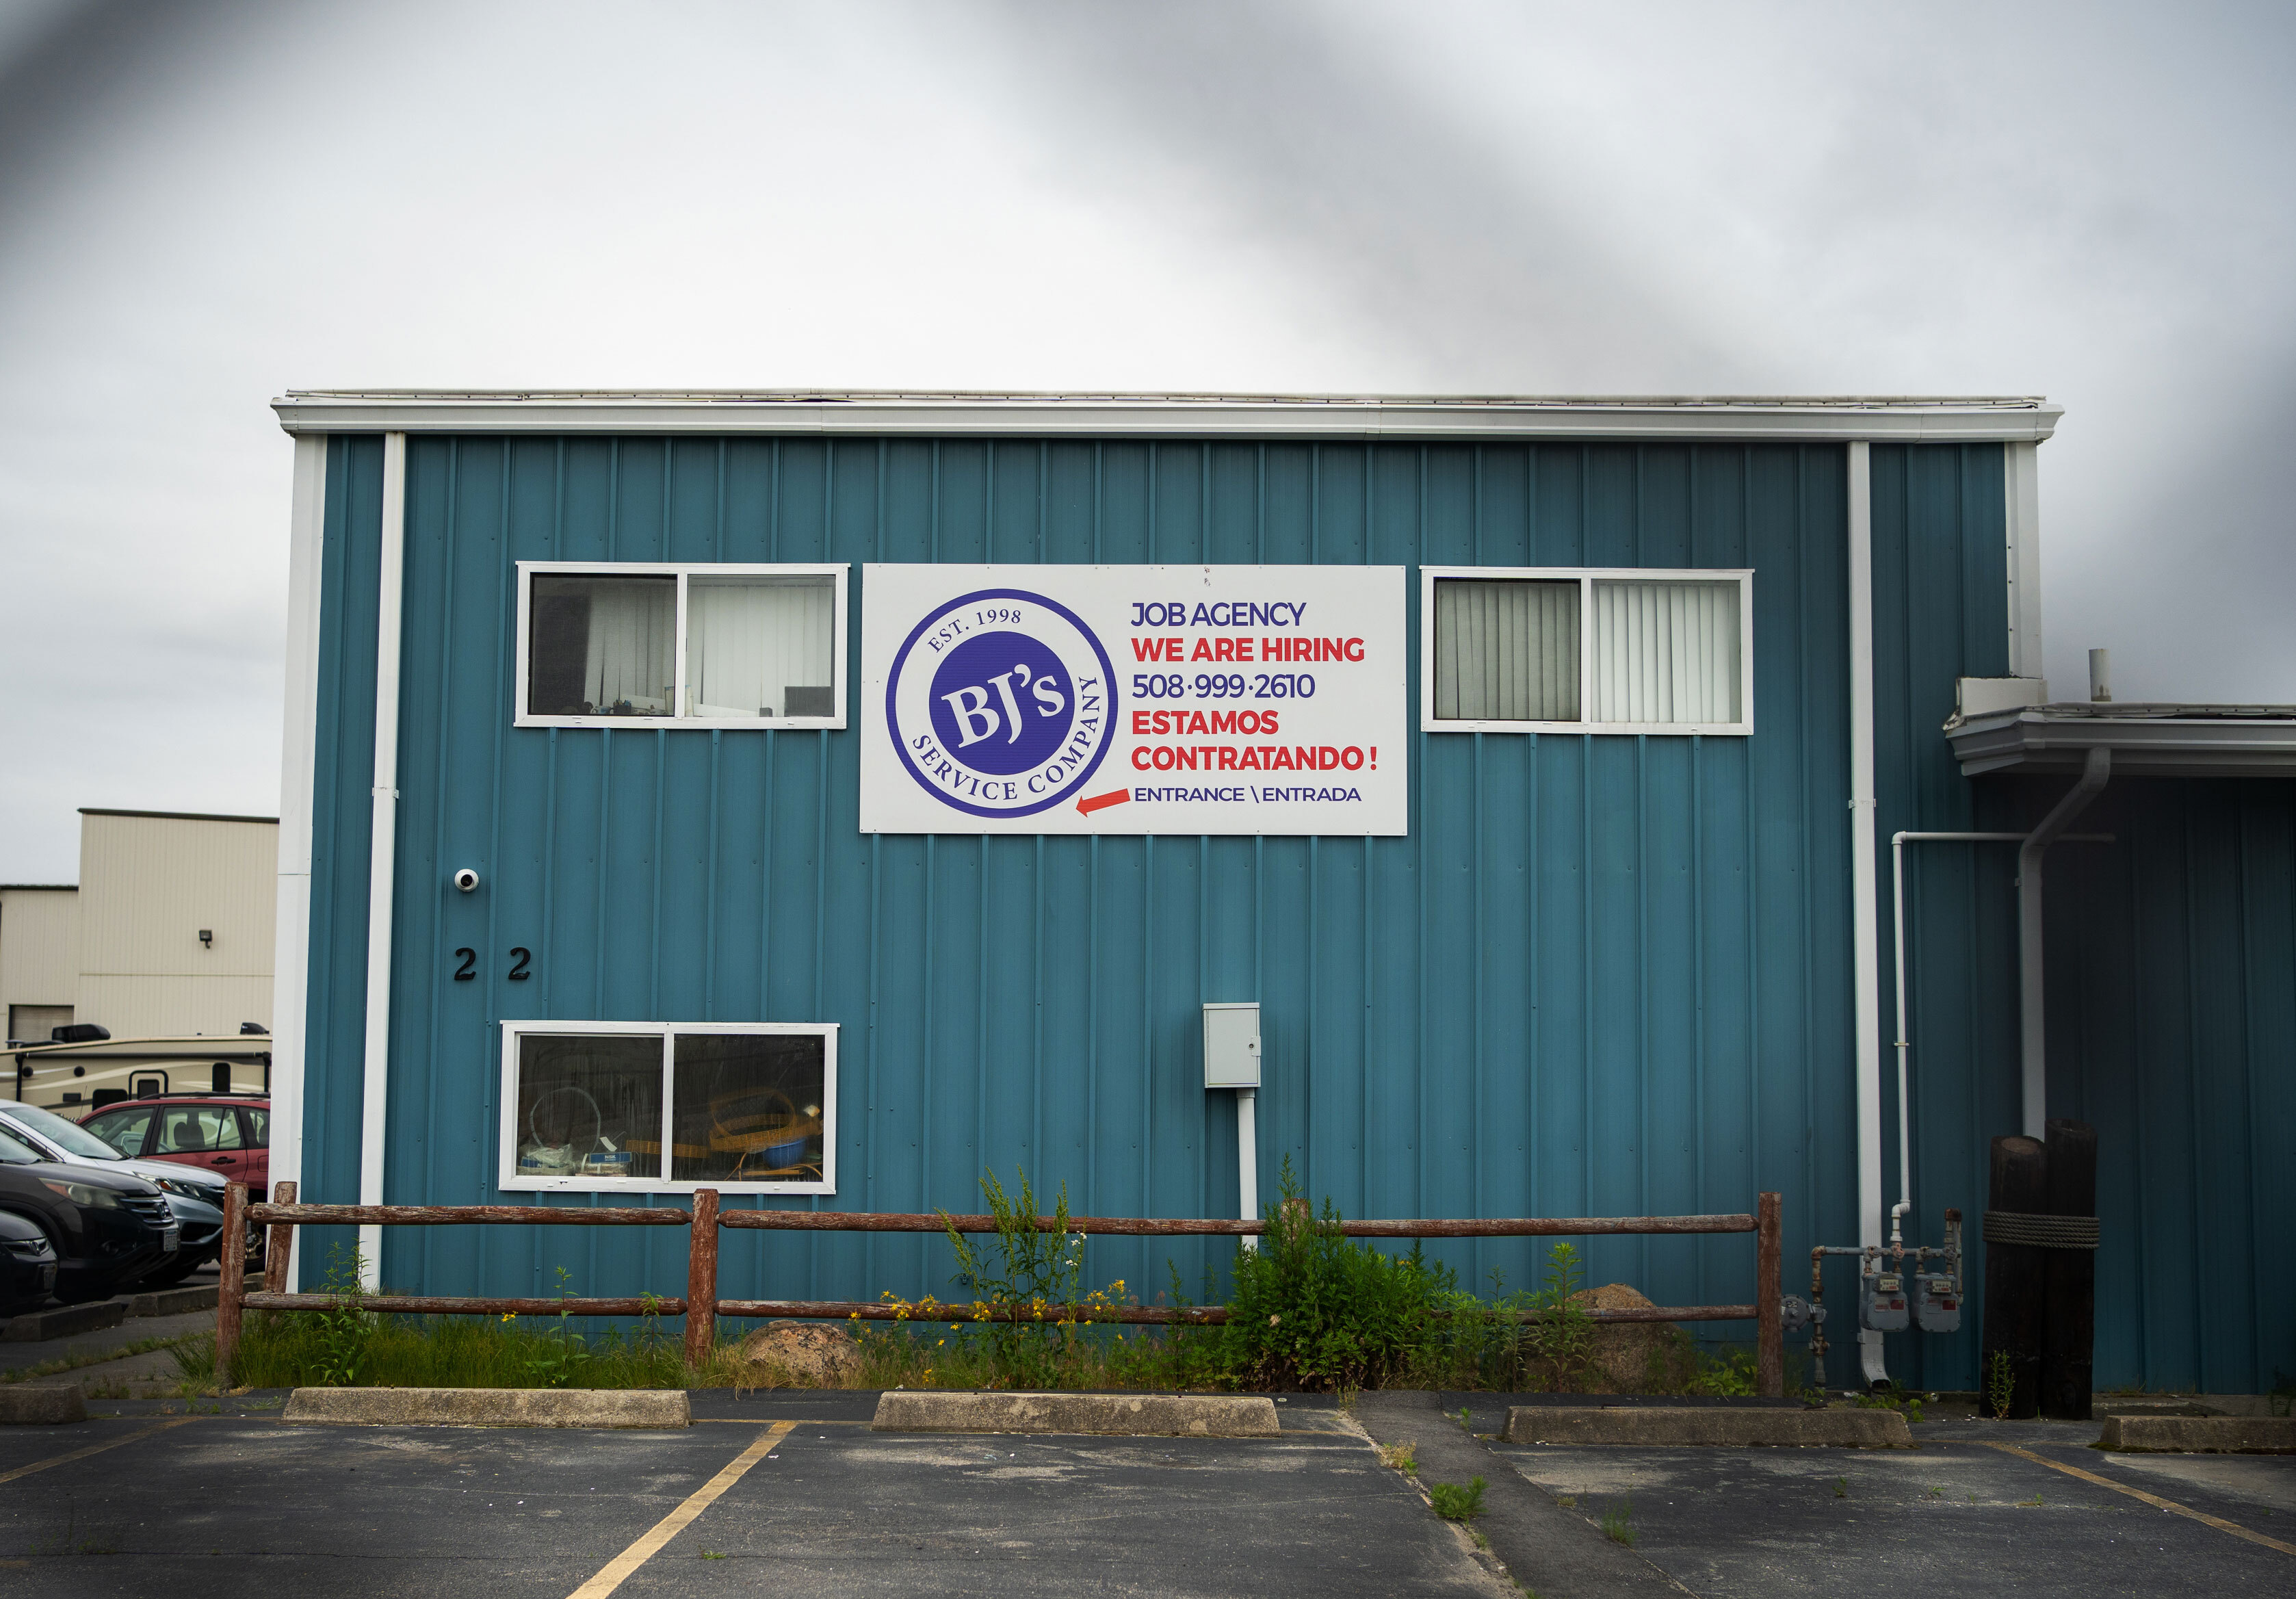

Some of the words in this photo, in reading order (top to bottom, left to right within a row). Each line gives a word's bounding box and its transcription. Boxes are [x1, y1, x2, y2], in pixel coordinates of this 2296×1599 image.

[1130, 602, 1186, 627] JOB
[1190, 602, 1307, 627] AGENCY
[927, 619, 969, 653] EST.
[976, 608, 1021, 626] 1998
[1130, 637, 1185, 662] WE
[1190, 637, 1254, 662] ARE
[1262, 637, 1365, 662] HIRING
[1132, 710, 1279, 736] ESTAMOS
[913, 735, 1018, 801] SERVICE
[1028, 676, 1100, 794] COMPANY
[1135, 787, 1245, 802] ENTRANCE
